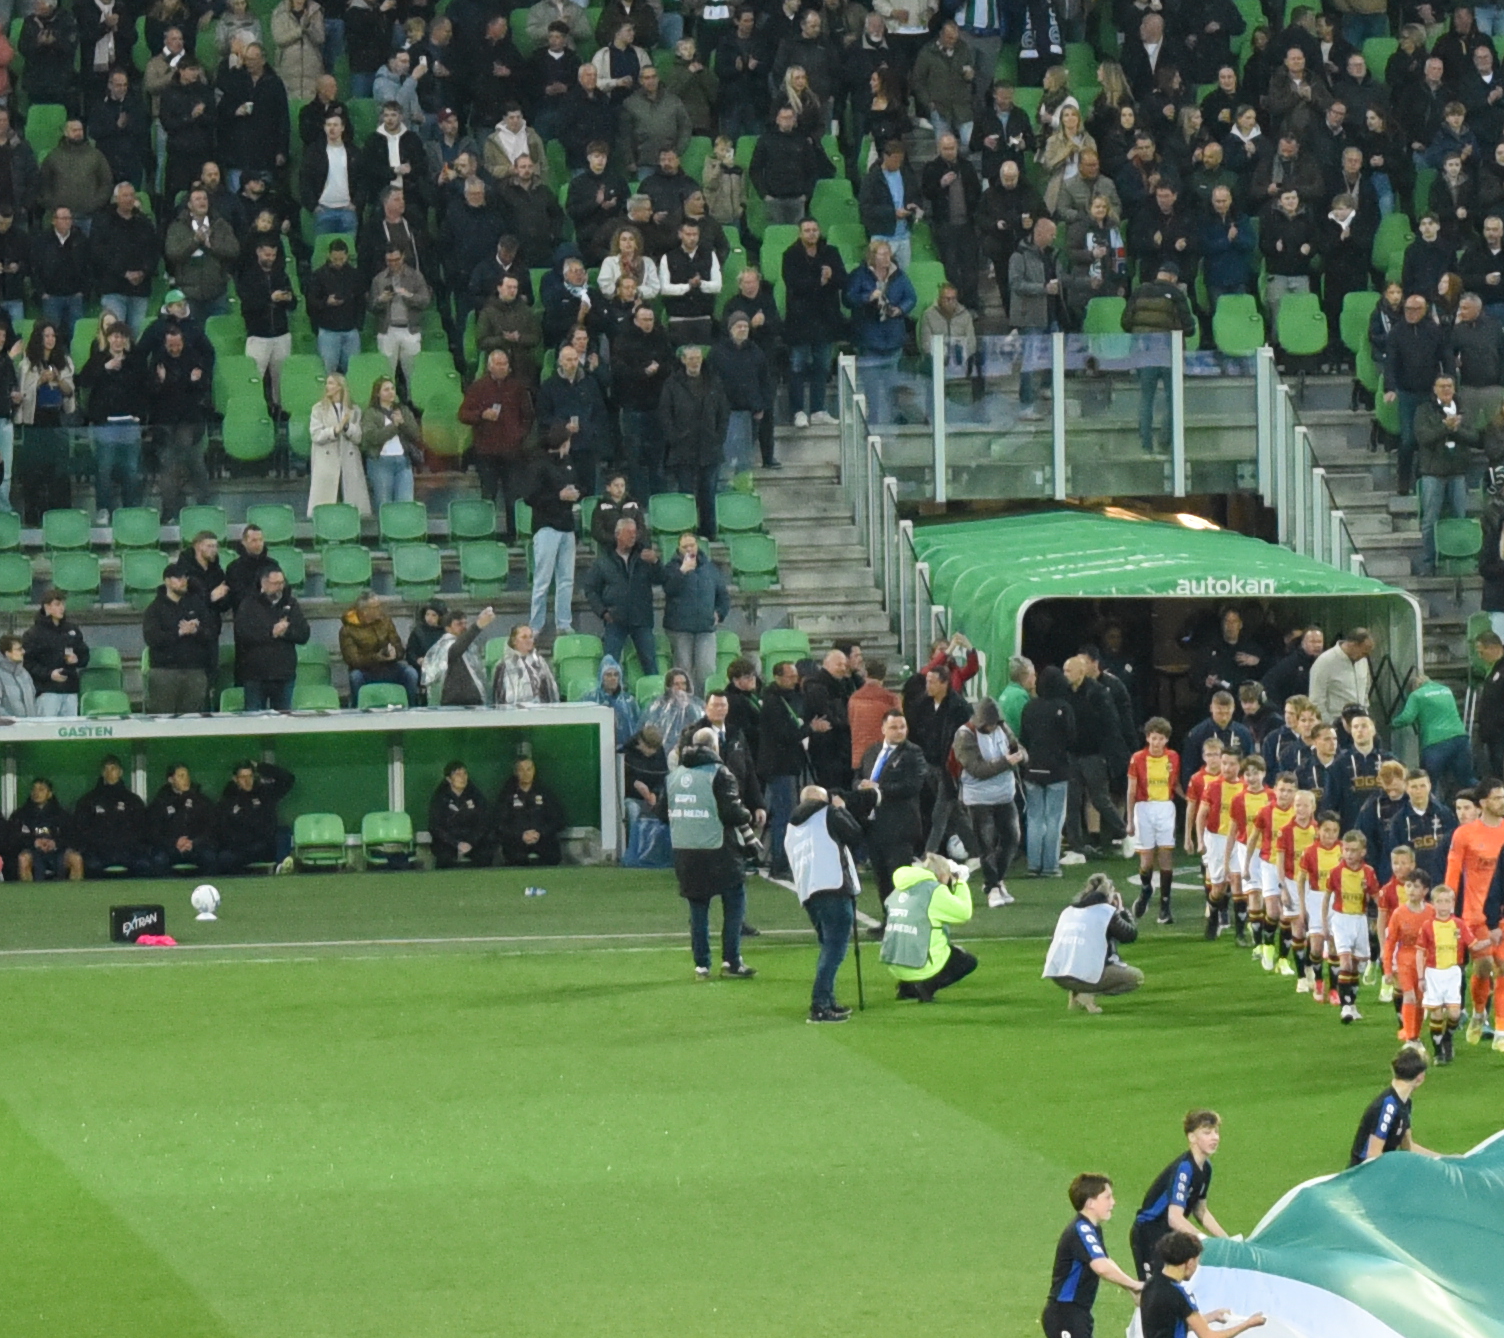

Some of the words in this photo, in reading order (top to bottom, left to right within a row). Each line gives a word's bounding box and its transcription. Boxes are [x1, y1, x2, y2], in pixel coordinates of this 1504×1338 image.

[1176, 574, 1276, 595] autokan
[57, 726, 114, 737] GASTEN
[122, 912, 158, 936] EXTRAN
